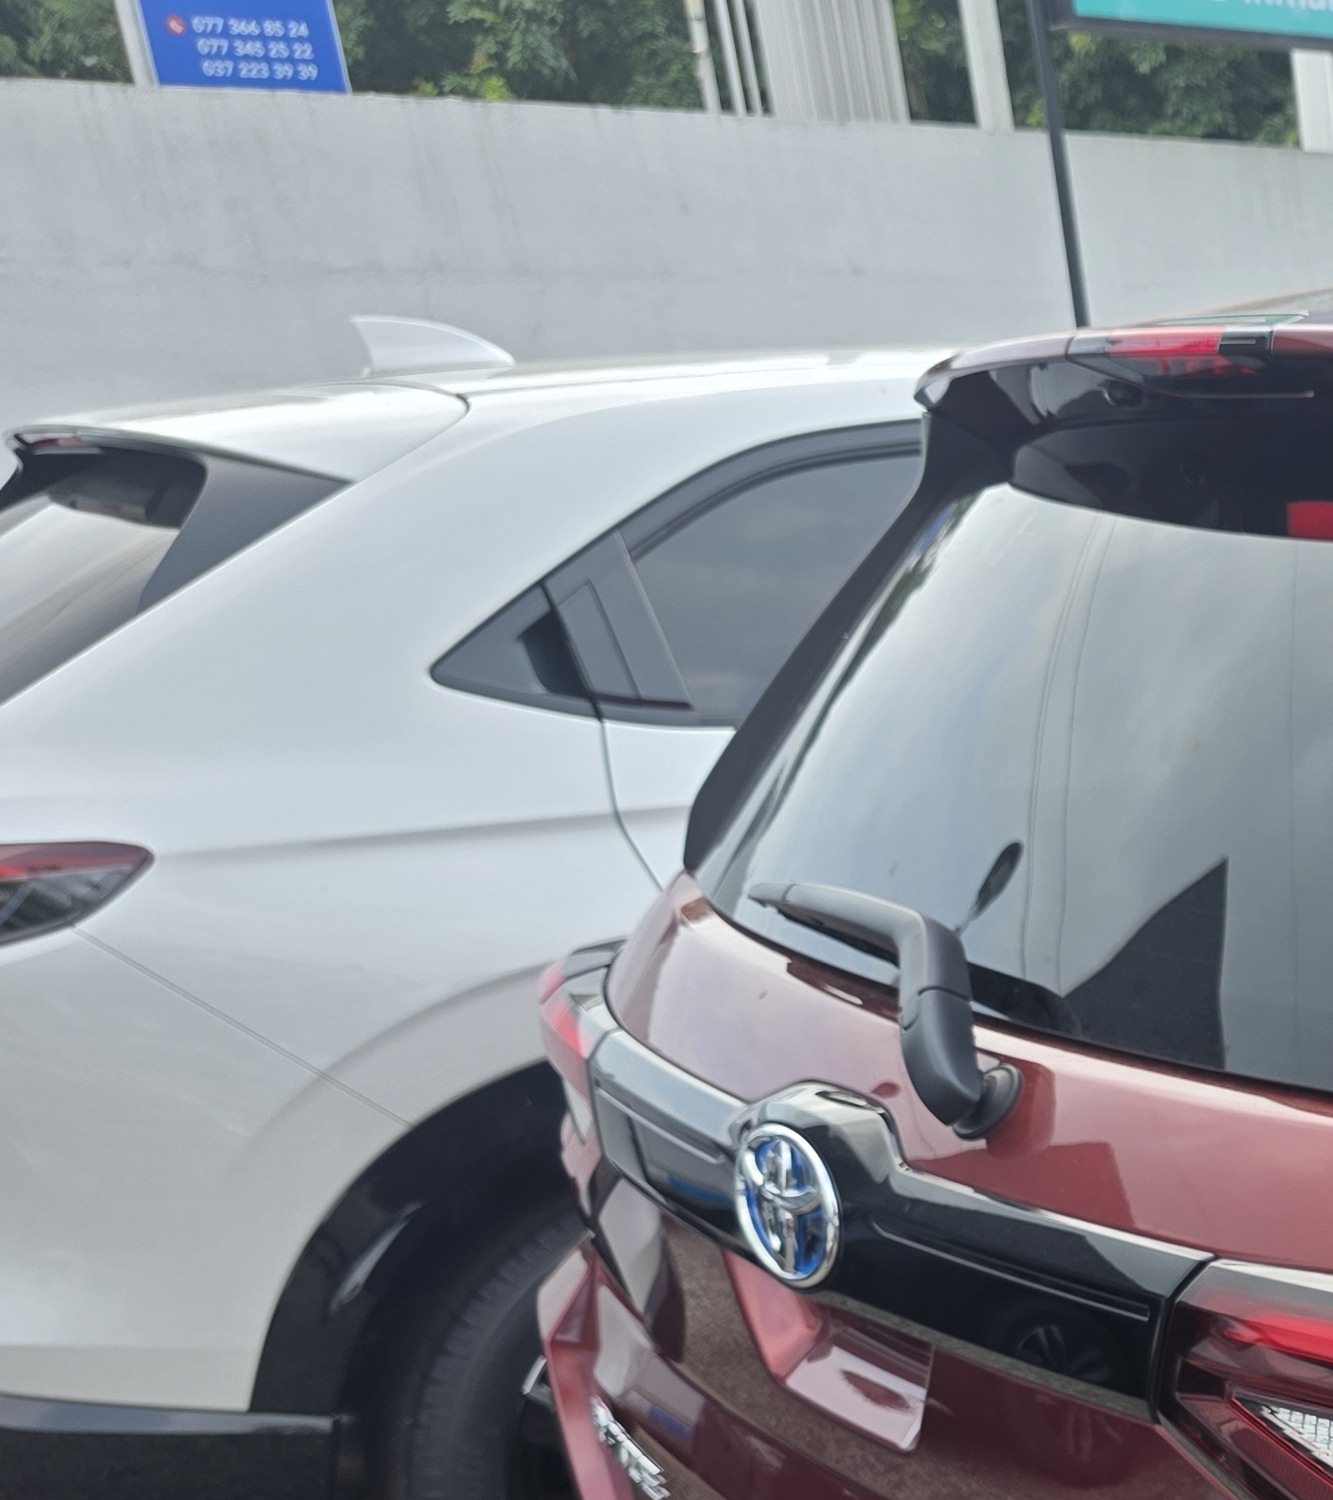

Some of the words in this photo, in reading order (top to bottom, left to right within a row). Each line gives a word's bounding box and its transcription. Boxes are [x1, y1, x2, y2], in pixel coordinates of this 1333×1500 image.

[192, 16, 225, 34] 077
[287, 20, 310, 38] 24
[197, 38, 229, 56] 077
[292, 42, 315, 60] 22
